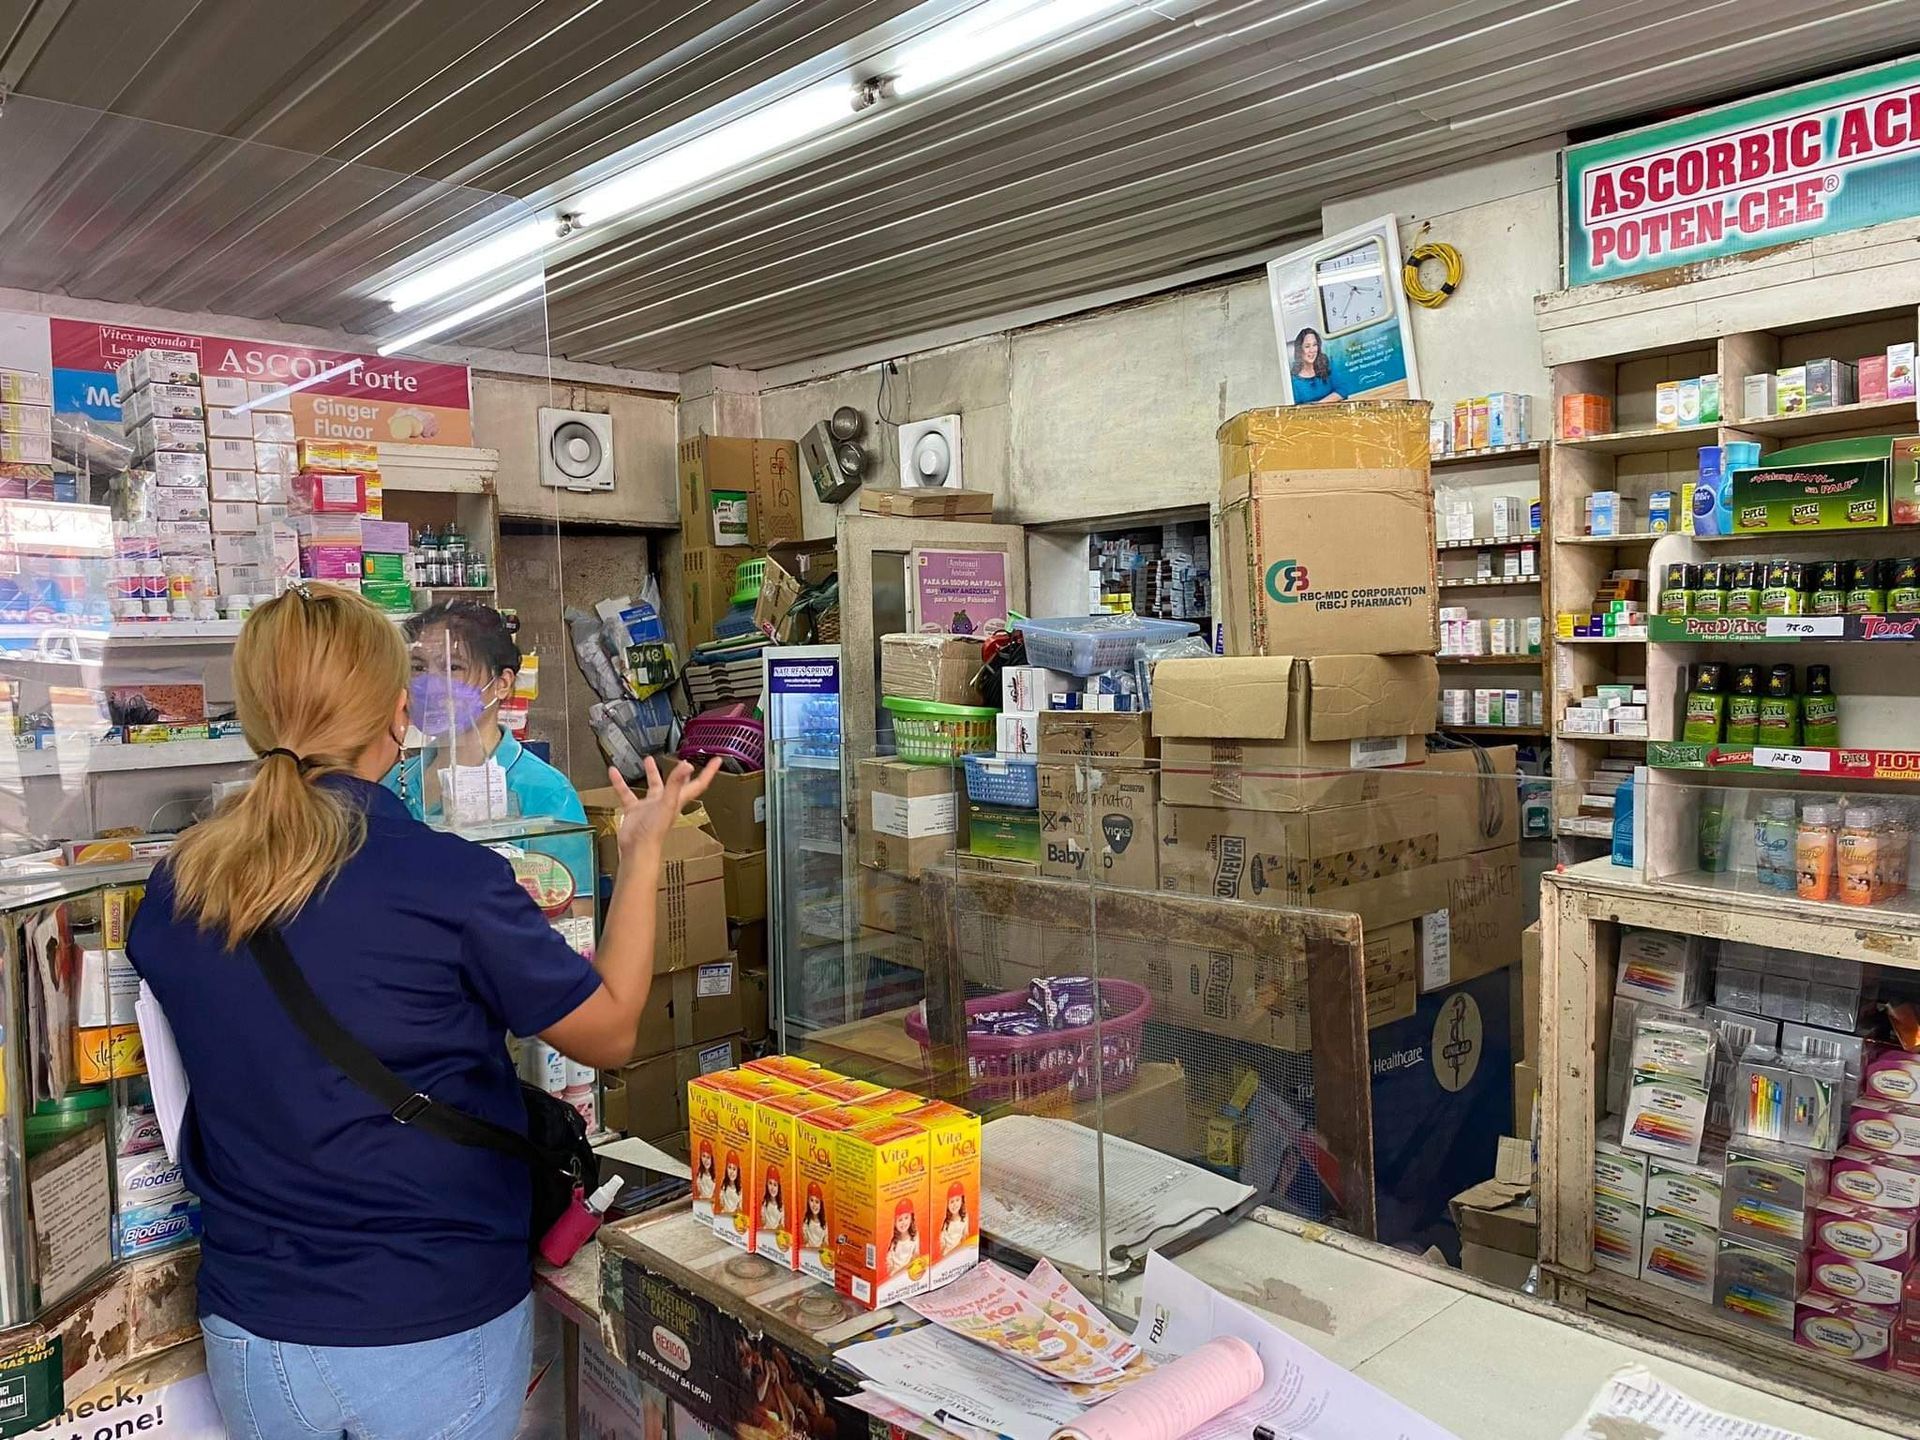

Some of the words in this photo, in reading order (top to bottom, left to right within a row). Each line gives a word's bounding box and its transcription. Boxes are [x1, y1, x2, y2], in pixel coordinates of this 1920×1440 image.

[1590, 119, 1822, 218] ASCORBIC
[102, 328, 134, 341] Vitex
[137, 335, 187, 347] negundo
[348, 358, 418, 392] Forte
[312, 399, 380, 423] Ginger
[314, 419, 373, 440] Flavor
[1741, 506, 1767, 519] PAU
[1793, 503, 1819, 517] PAU
[1850, 501, 1876, 515] PAU
[1300, 590, 1348, 601] RBC-MDC
[1352, 586, 1426, 599] CORPORATION
[1316, 600, 1347, 612] (RBCJ
[1350, 596, 1412, 609] PHARMACY)
[1877, 752, 1920, 770] HOT
[1048, 843, 1085, 870] Baby
[1374, 1046, 1423, 1075] Healthcare
[720, 1095, 739, 1114] Vita
[757, 1110, 778, 1129] Vita
[797, 1124, 817, 1144] Vita
[937, 1132, 962, 1146] Vita
[881, 1149, 909, 1164] Vita
[124, 1217, 187, 1243] Bioderm
[640, 1279, 698, 1323] PARACETAMOL
[1148, 1317, 1165, 1344] FDA
[33, 1385, 144, 1432] heck,
[93, 1405, 164, 1440] one!
